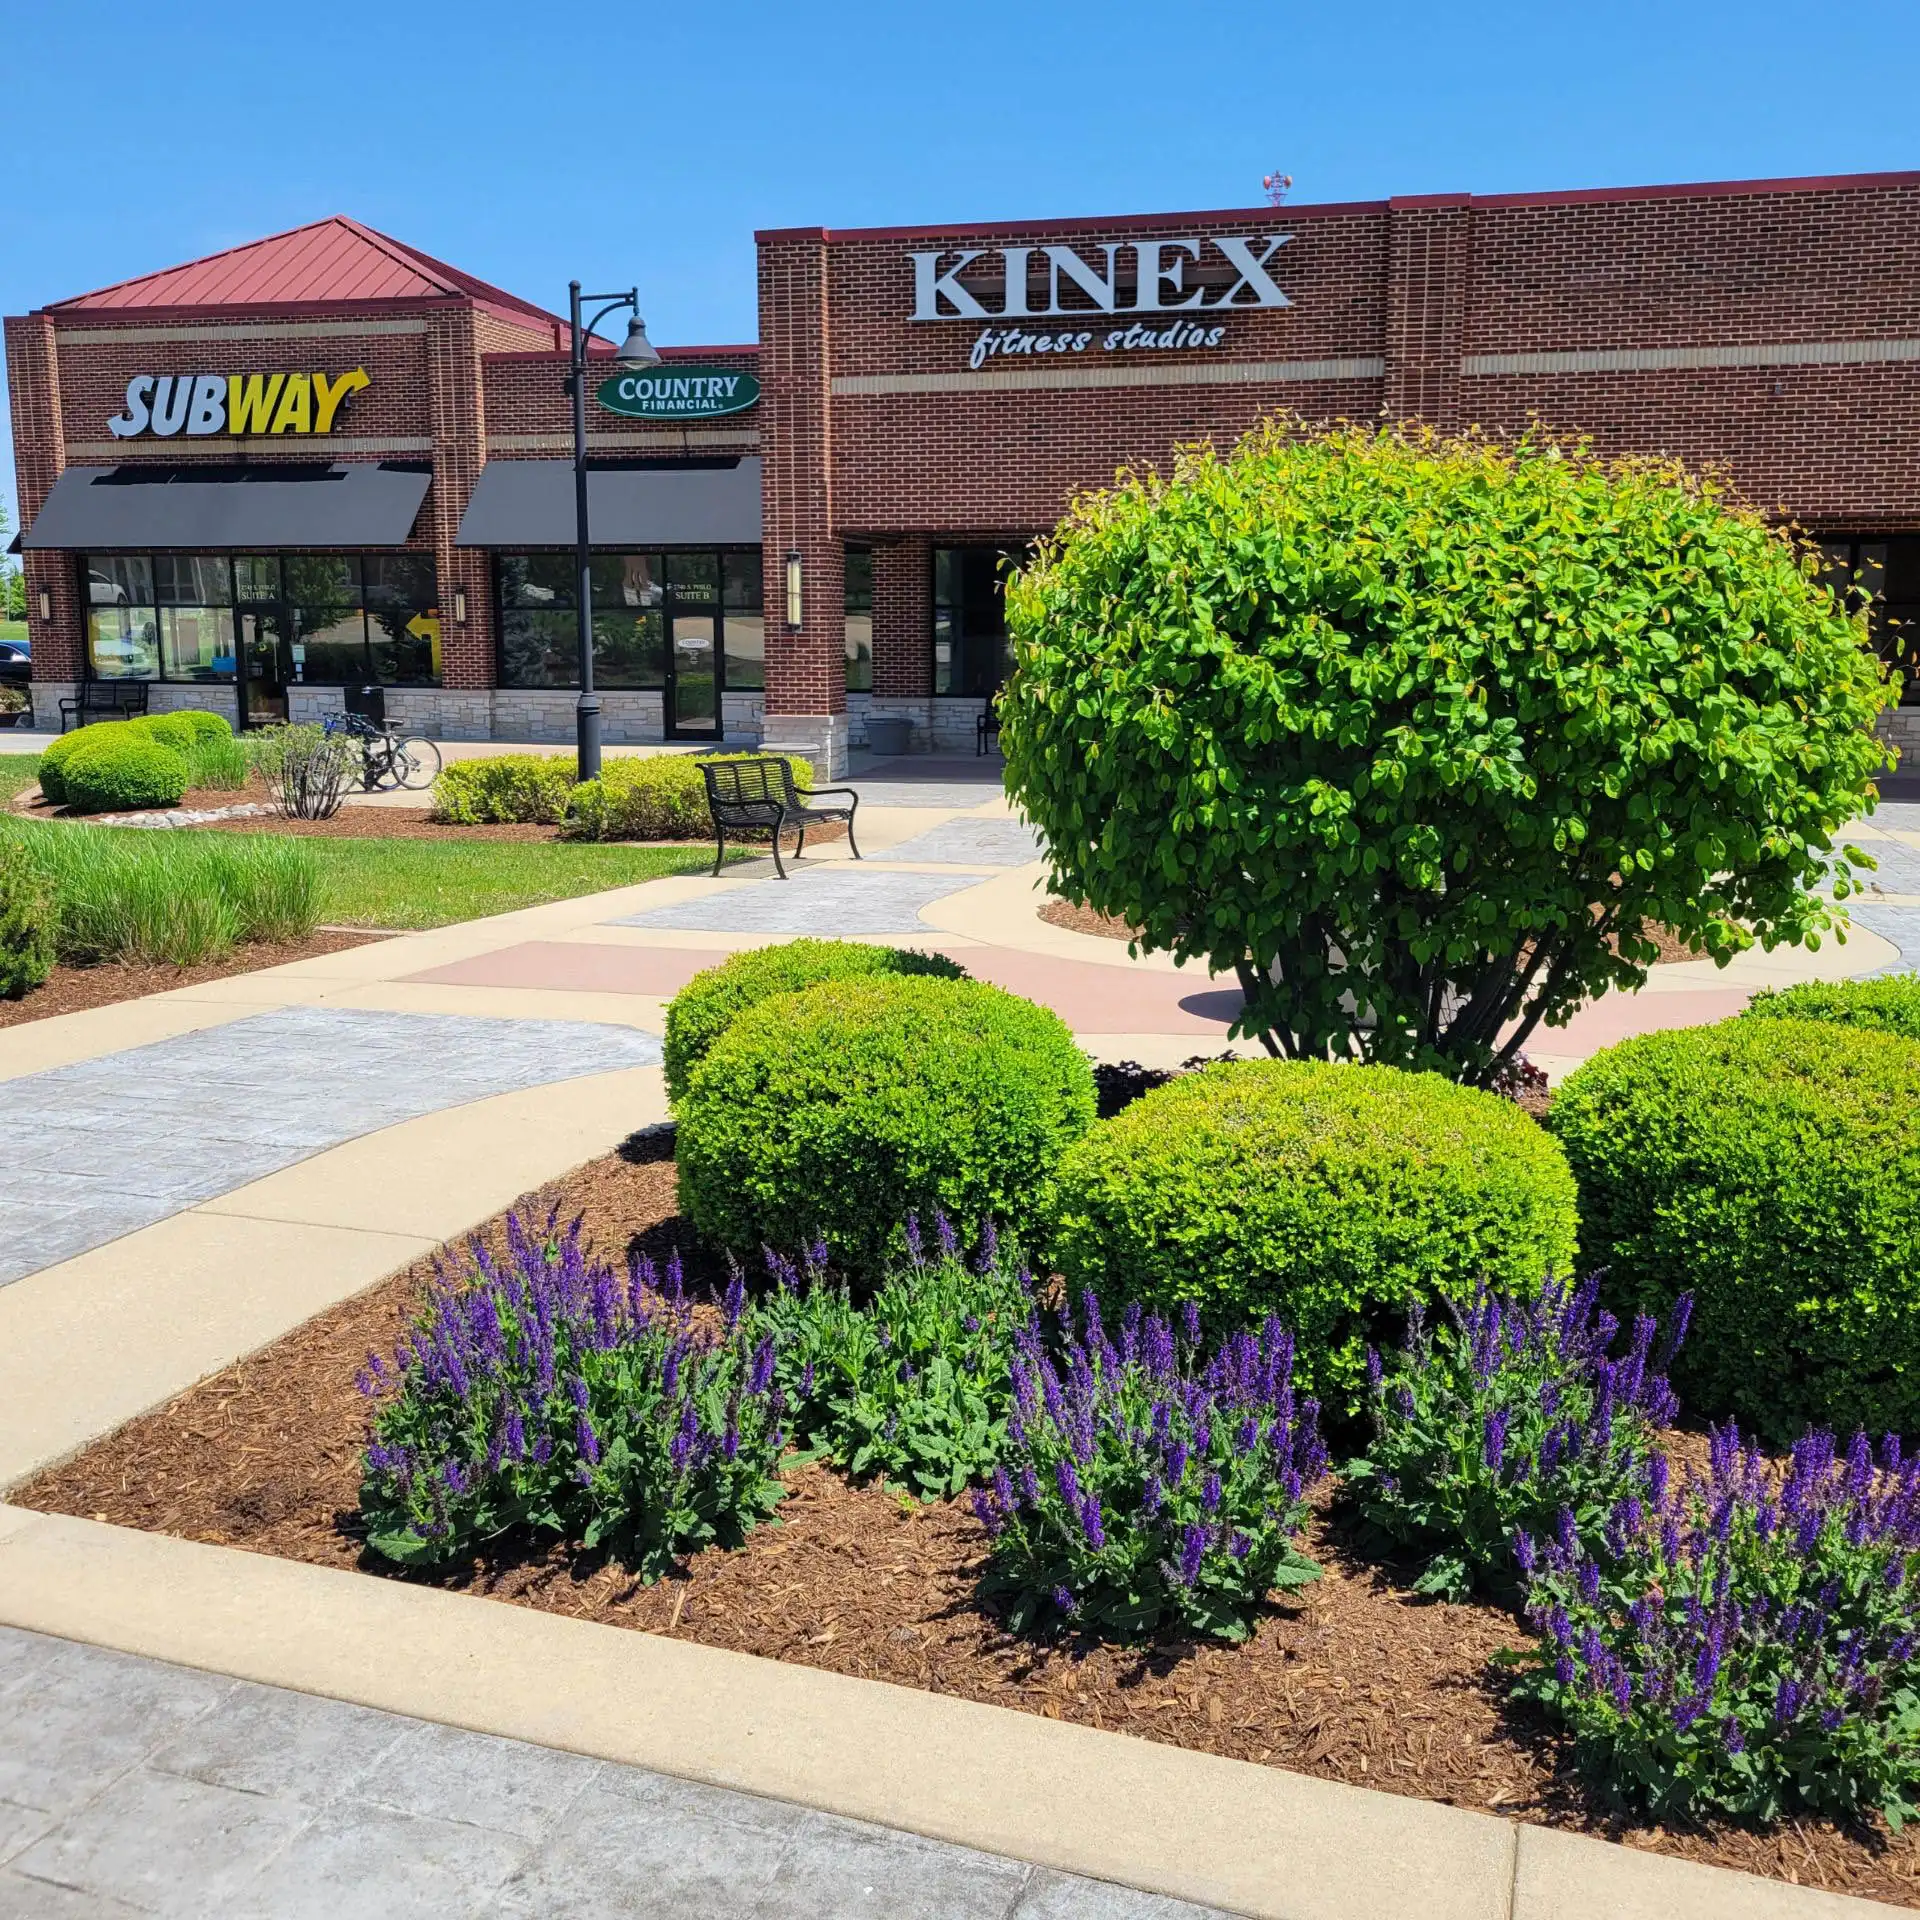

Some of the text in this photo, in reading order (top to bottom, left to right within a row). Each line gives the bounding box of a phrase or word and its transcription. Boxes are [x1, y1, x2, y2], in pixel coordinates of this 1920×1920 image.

[905, 235, 1295, 322] KINEX
[969, 320, 1226, 370] fitness studios
[106, 365, 372, 438] SUBWAY
[618, 376, 740, 400] COUNTRY
[241, 591, 275, 600] SUITE A
[675, 591, 710, 600] SUITE B
